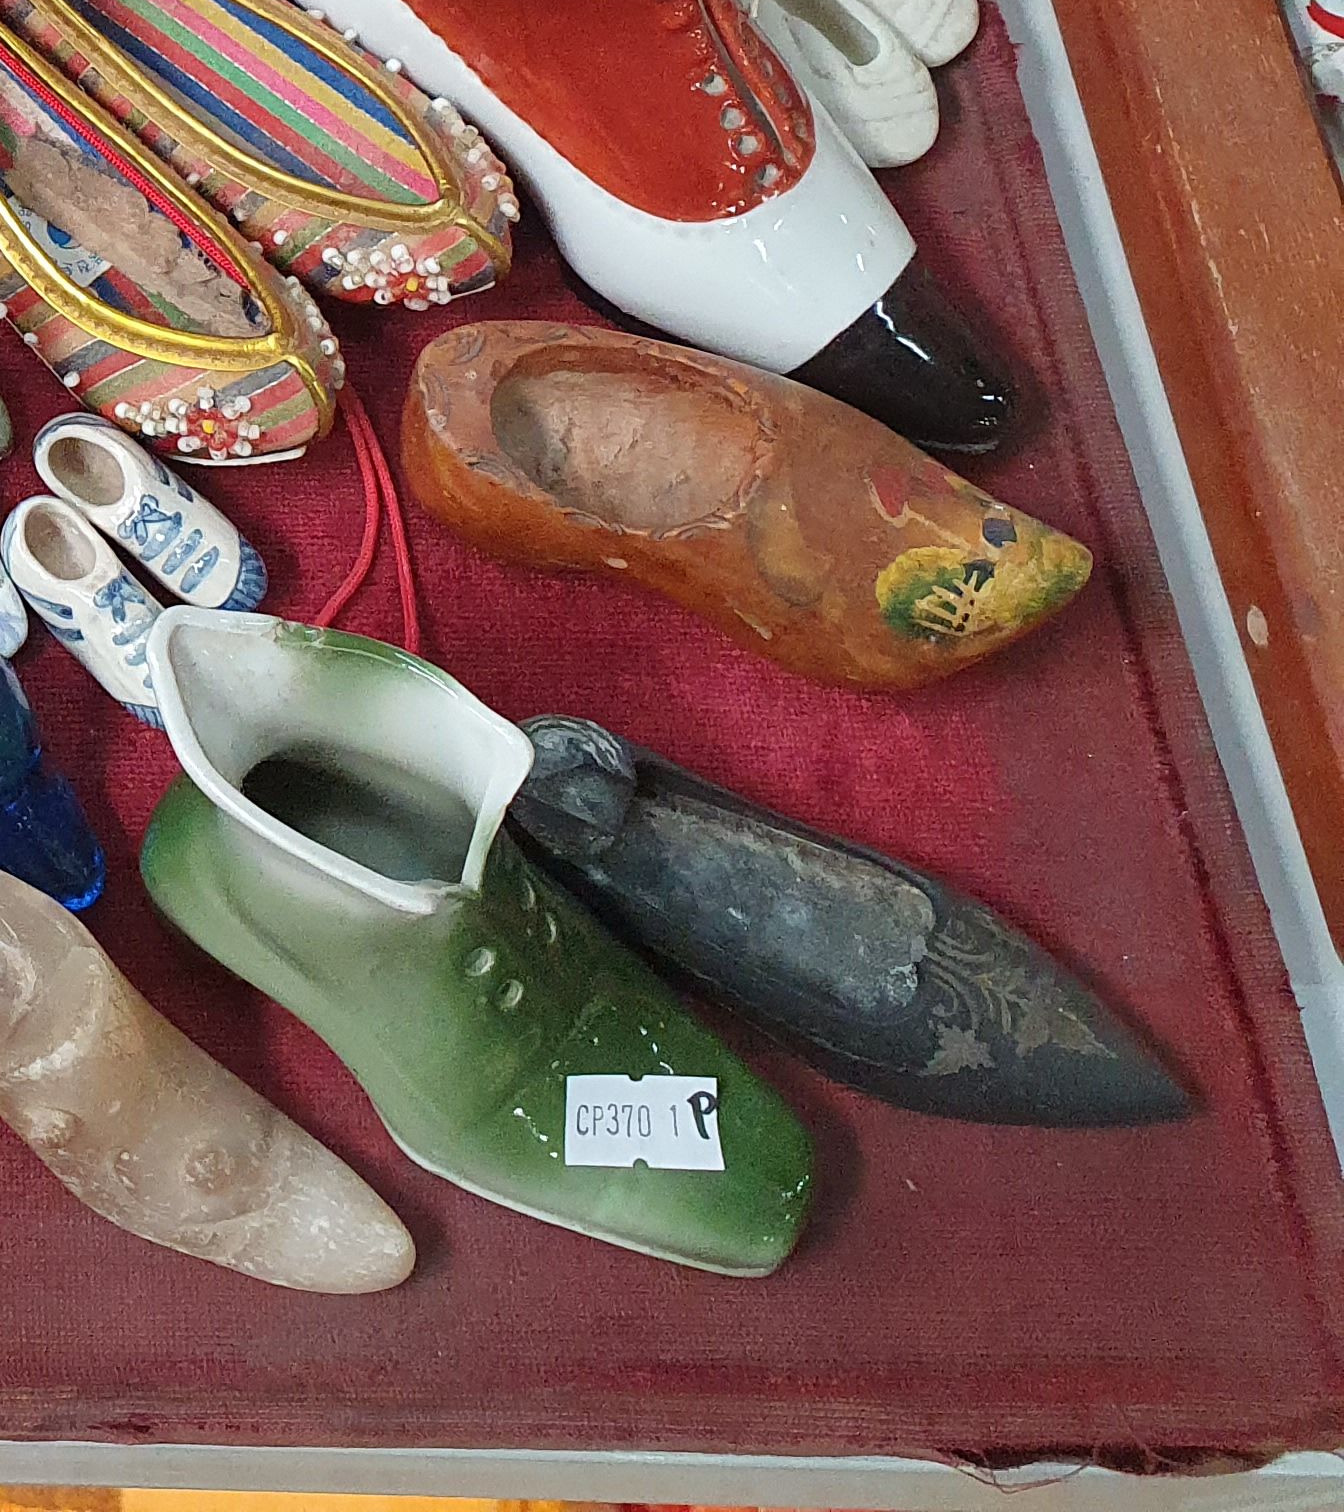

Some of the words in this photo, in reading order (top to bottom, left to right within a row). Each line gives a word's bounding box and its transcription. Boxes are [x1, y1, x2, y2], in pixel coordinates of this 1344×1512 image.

[576, 1103, 652, 1138] CP370
[669, 1104, 679, 1138] 1
[686, 1090, 719, 1140] P
